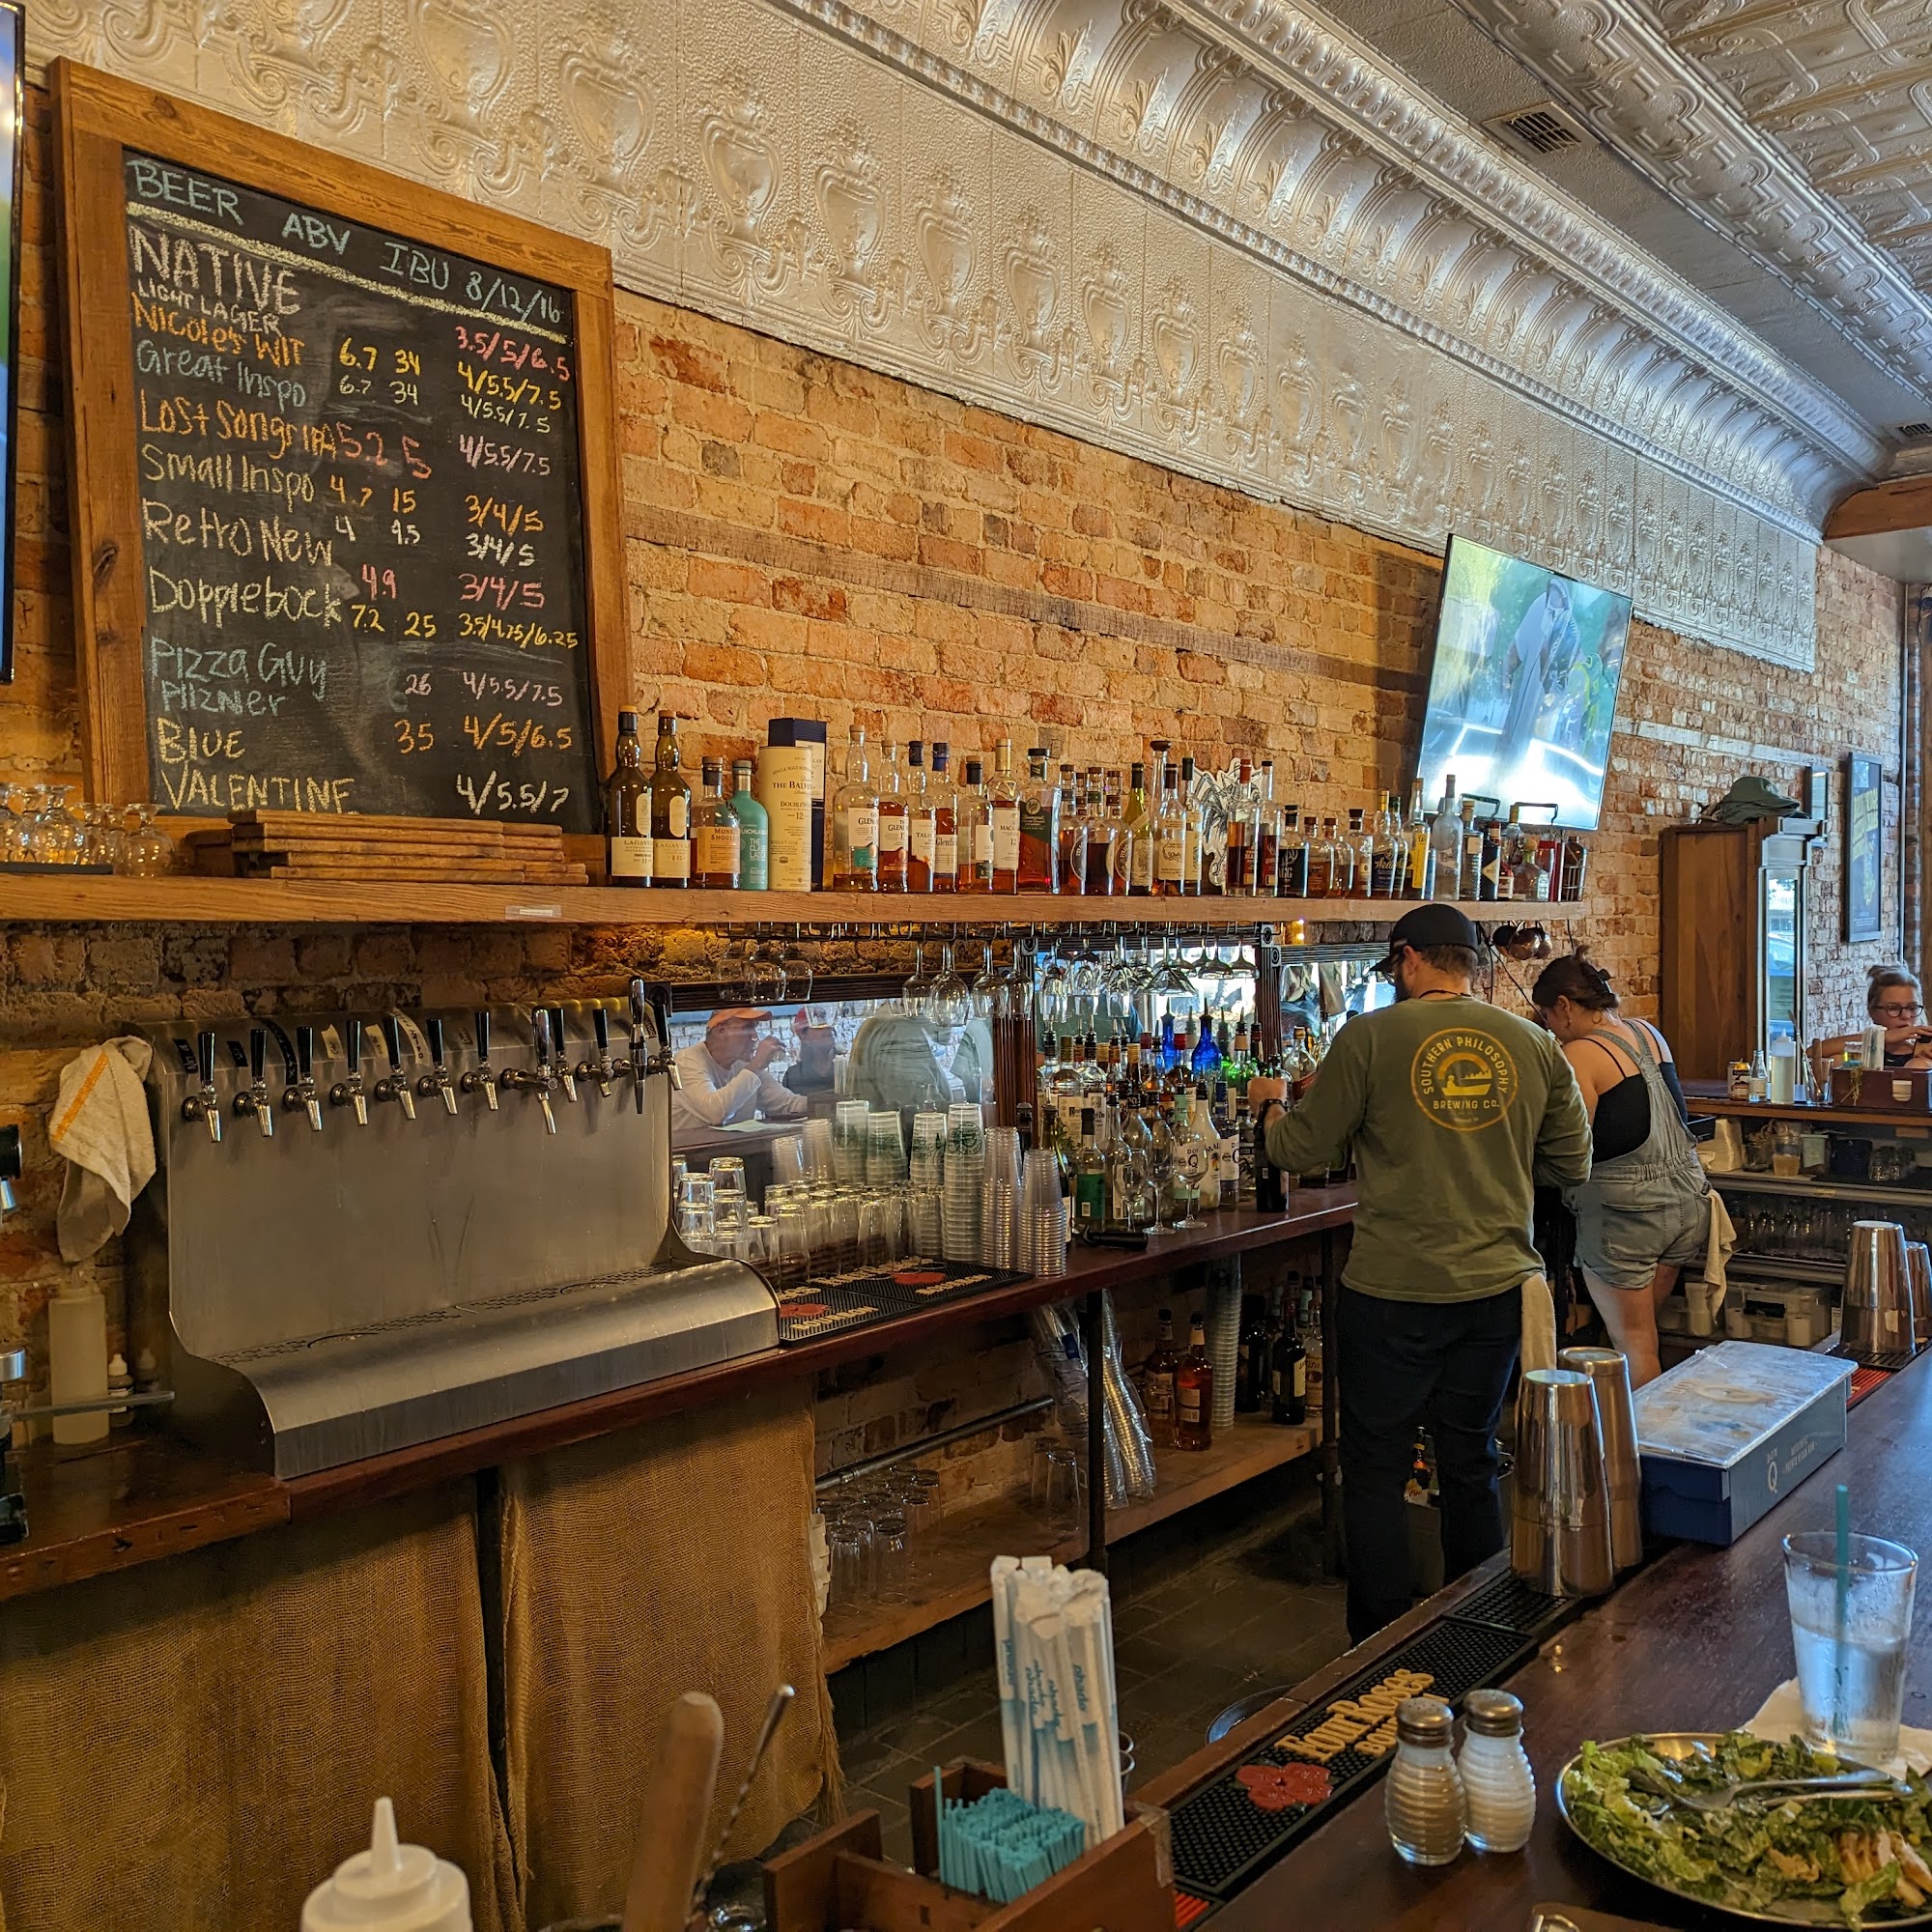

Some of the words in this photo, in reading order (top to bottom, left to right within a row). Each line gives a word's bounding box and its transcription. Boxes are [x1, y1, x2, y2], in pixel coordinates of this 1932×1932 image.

[127, 159, 243, 225] BEER
[282, 213, 350, 255] ABV
[380, 242, 449, 290] IBU
[128, 225, 300, 315] NATIVE
[138, 277, 193, 309] LIGHT
[200, 295, 282, 337] LAGER
[137, 339, 230, 384] Great
[339, 375, 372, 395] 6.7
[388, 381, 419, 406] 34
[339, 337, 378, 372] 6.7
[394, 349, 421, 376] 34
[402, 436, 433, 479] 5
[141, 443, 232, 494] Small
[393, 487, 417, 514] 15
[466, 494, 545, 537] 3/4/5
[142, 497, 252, 556] Retro
[259, 515, 332, 567] New
[335, 515, 356, 542] 4
[466, 532, 535, 567] 3/4/5
[459, 573, 546, 611] 3/4/5
[403, 611, 437, 639] 25
[463, 671, 563, 707] 4/5.5/7.5
[394, 718, 435, 754] 35
[464, 712, 573, 757] 4/5/6.5
[160, 759, 360, 815] VALENTINE
[456, 770, 570, 815] 4/5.5/7
[789, 781, 811, 789] BALVE
[1421, 1037, 1453, 1095] SOUTHERN
[1457, 1037, 1509, 1094] PHILOSOPHY
[1433, 1099, 1479, 1110] BREWING
[1483, 1099, 1500, 1110] CO.
